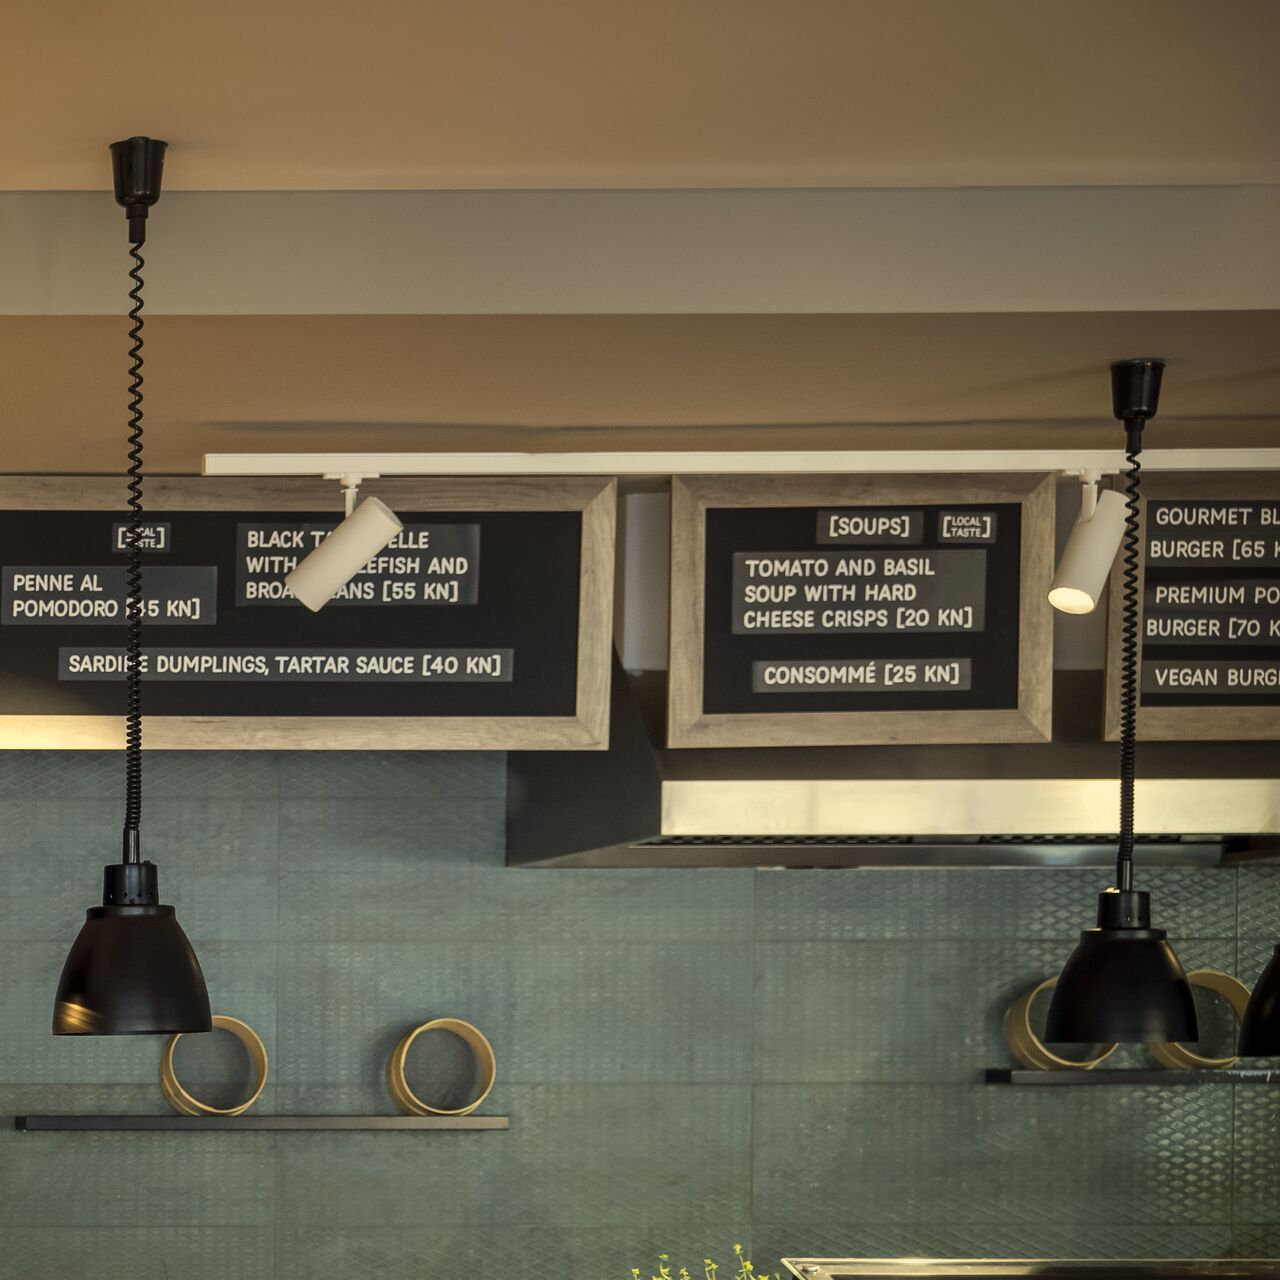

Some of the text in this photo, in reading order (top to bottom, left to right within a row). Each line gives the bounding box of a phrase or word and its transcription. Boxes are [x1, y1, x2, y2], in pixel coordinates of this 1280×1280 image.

[1156, 507, 1252, 525] GOURMET
[829, 516, 909, 538] [SOUPS]
[248, 531, 304, 548] BLACK
[1151, 540, 1224, 558] BURGER
[1233, 539, 1264, 560] [65
[246, 557, 297, 574] WITH
[428, 557, 468, 574] AND
[745, 558, 935, 577] TOMATO AND BASIL
[14, 575, 103, 592] PENNE AL
[246, 581, 295, 599] BROA
[383, 580, 416, 601] [55
[424, 581, 458, 602] KN]
[745, 584, 916, 603] SOUP WITH HARD
[1156, 586, 1244, 604] PREMIUM
[13, 600, 118, 617] POMODORO
[167, 598, 200, 619] KN]
[744, 606, 972, 629] CHEESE CRISPS [20 KN]
[1147, 619, 1220, 636] BURGER
[1229, 618, 1260, 638] [70
[157, 656, 269, 676] DUMPLINGS,
[275, 656, 349, 673] TARTAR
[356, 656, 414, 674] SAUCE
[422, 655, 458, 676] [40
[467, 655, 501, 677] KN]
[764, 661, 959, 685] CONSOMMÉ [25 KN]
[1155, 669, 1217, 686] VEGAN
